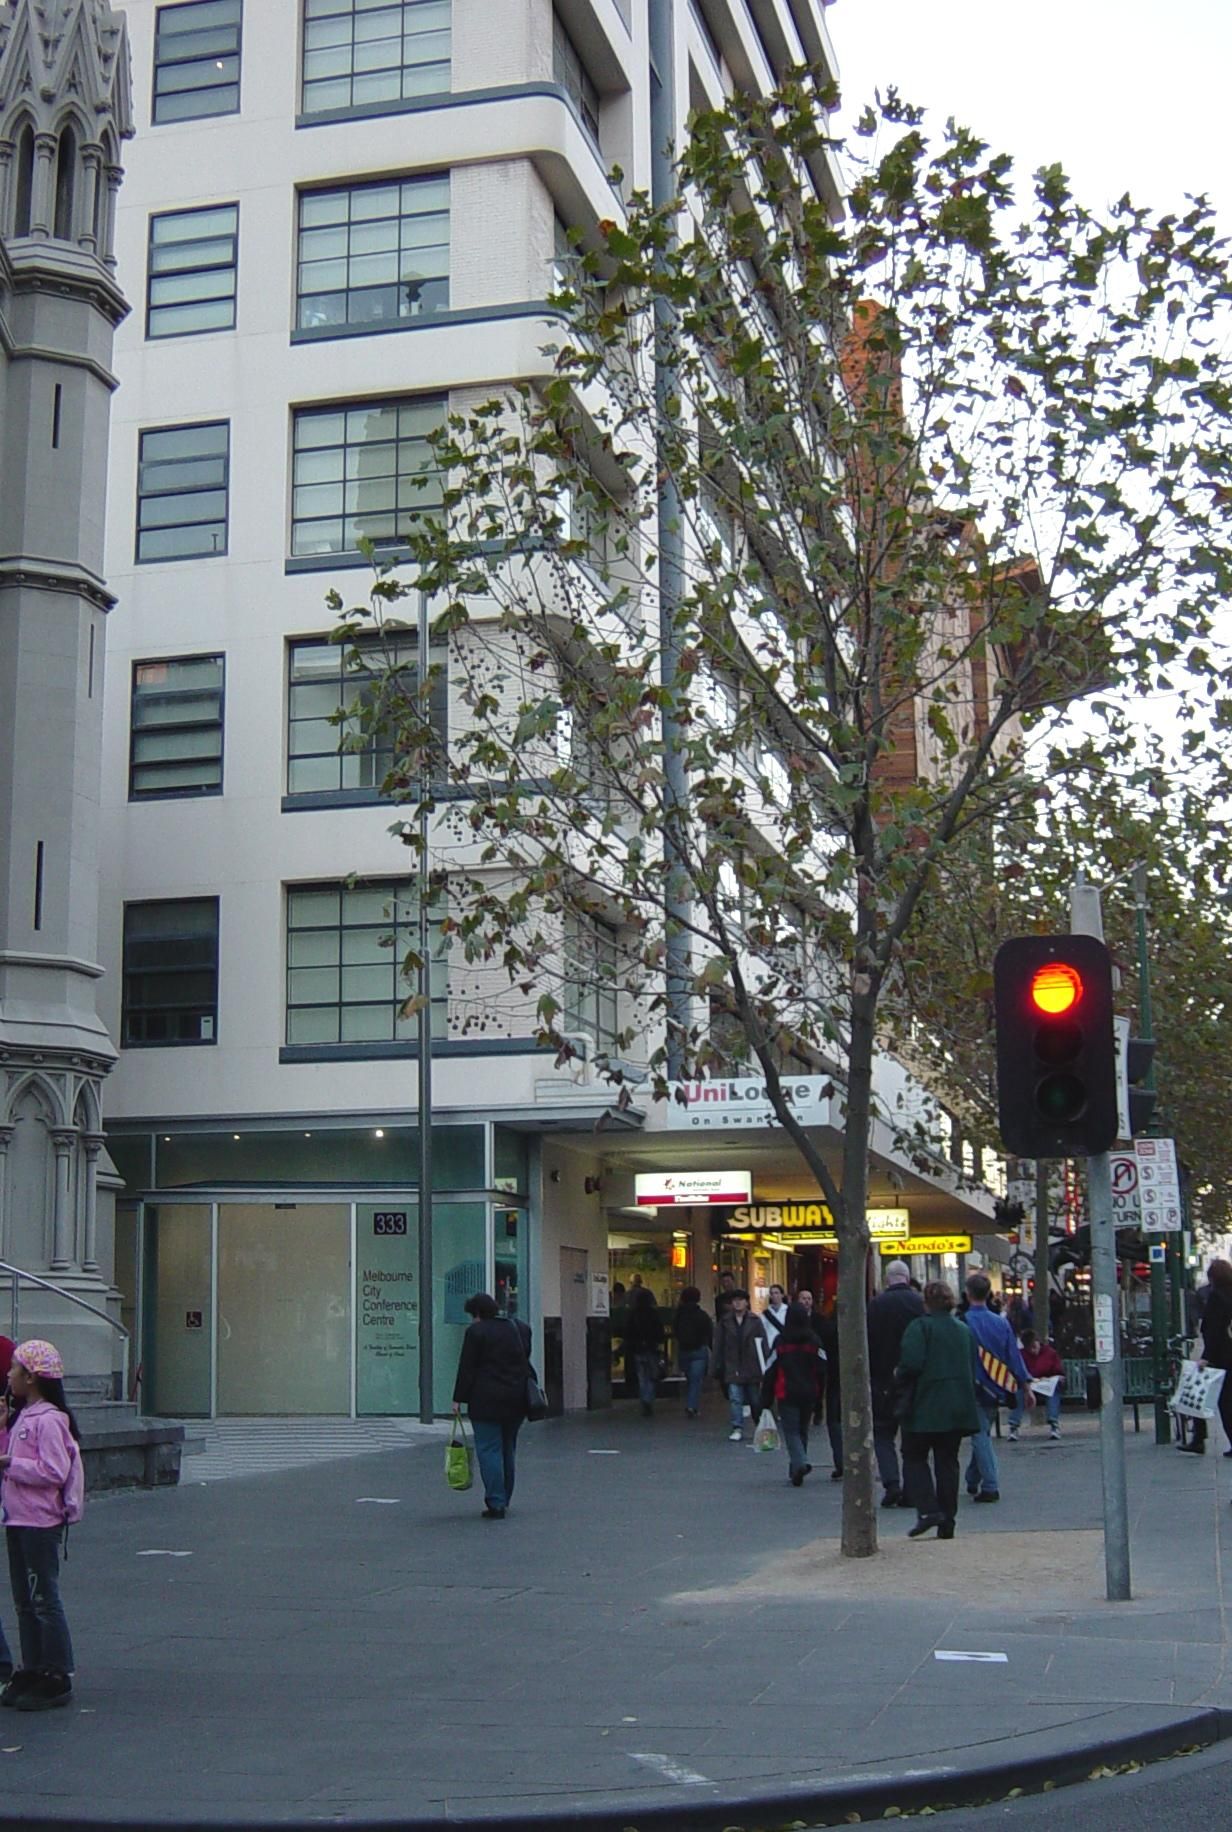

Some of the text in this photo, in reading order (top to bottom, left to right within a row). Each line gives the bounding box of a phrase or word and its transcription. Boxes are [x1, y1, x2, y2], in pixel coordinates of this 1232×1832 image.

[692, 1112, 804, 1126] On Swann
[679, 1179, 722, 1188] National
[376, 1214, 405, 1233] 333
[896, 1240, 954, 1251] Nando's
[363, 1270, 413, 1282] Melbourne
[362, 1284, 381, 1299] City
[362, 1299, 418, 1311] Conference
[362, 1313, 395, 1326] Centre
